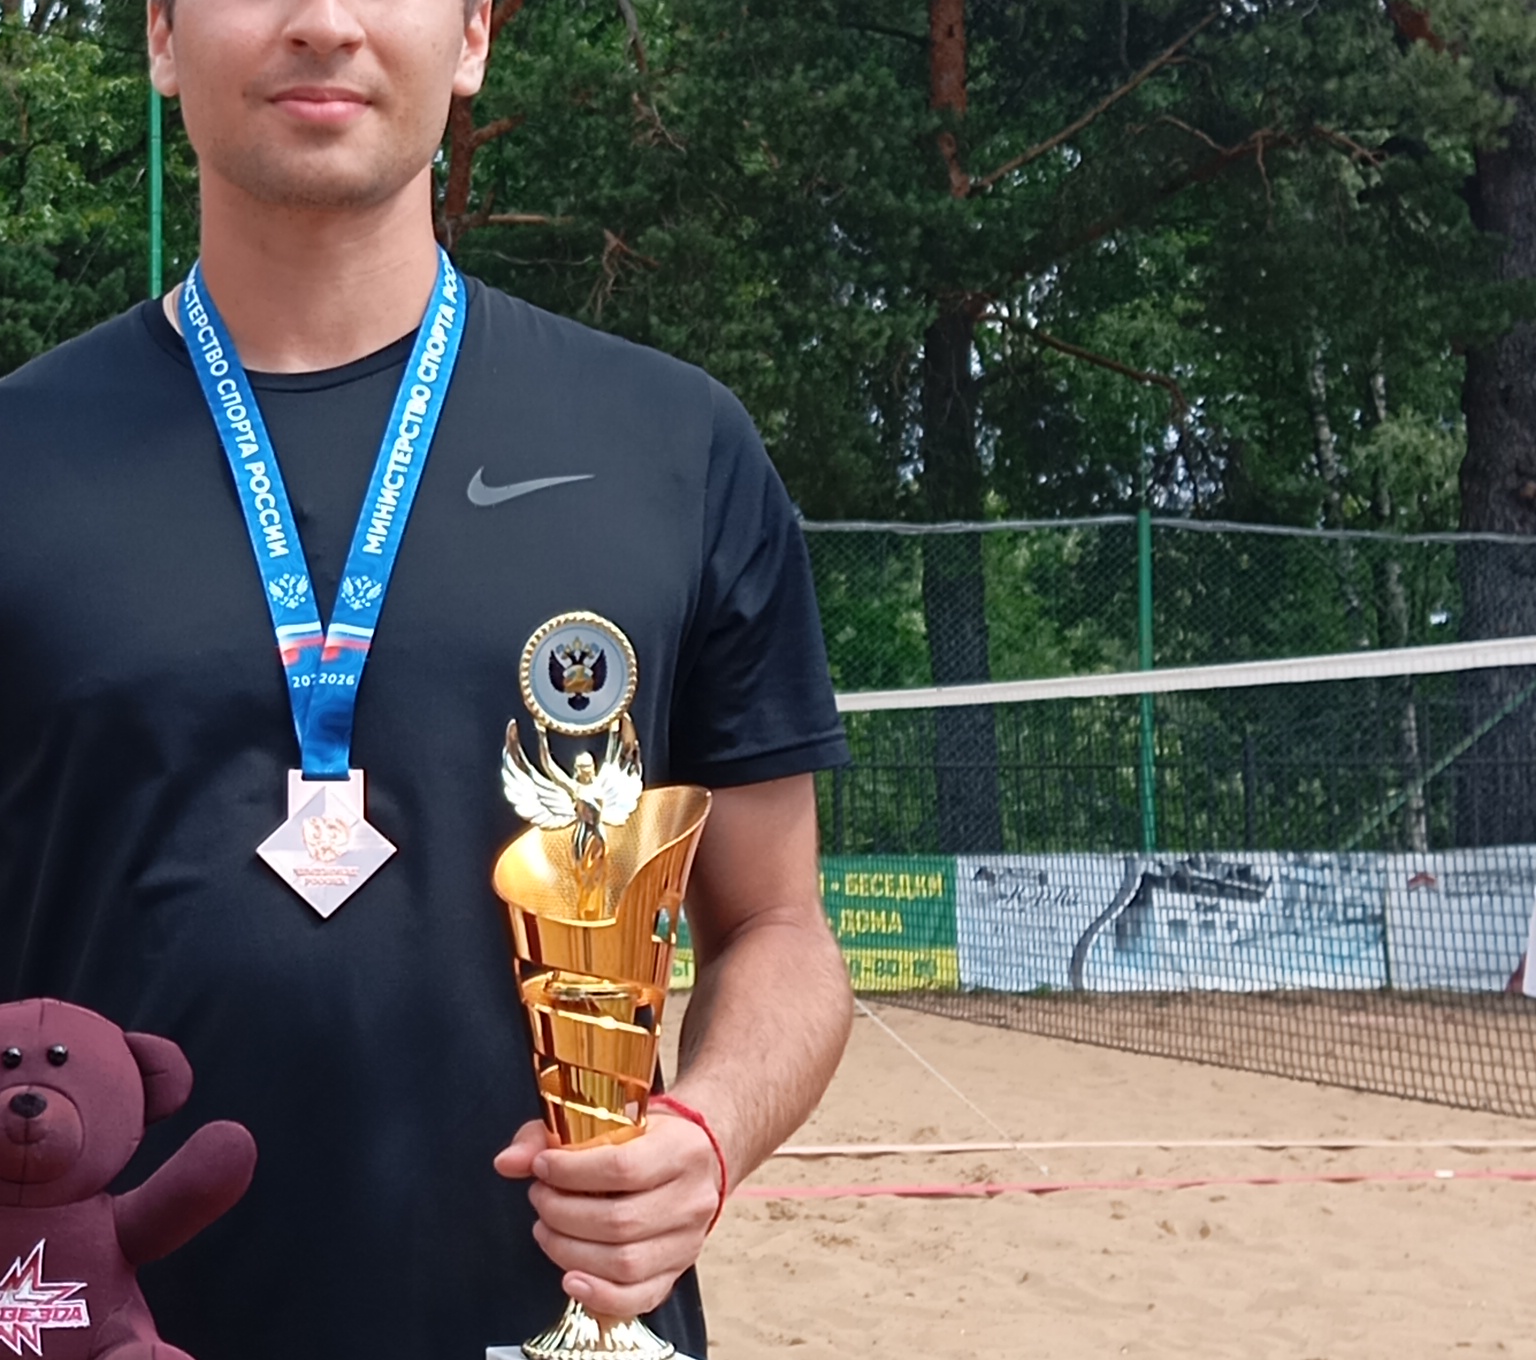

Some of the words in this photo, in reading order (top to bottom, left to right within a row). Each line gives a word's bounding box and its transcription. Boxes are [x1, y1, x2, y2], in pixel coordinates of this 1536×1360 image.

[185, 258, 229, 377] СТЕРСТВО
[217, 379, 259, 458] СПОРТА
[244, 461, 289, 558] РОССИИ
[362, 384, 431, 555] МИНИСТЕРСТВО
[417, 303, 456, 383] СПОРТА
[319, 672, 355, 686] 2026
[845, 871, 943, 900] БЕСЕДКИ
[837, 908, 903, 938] ДОМА
